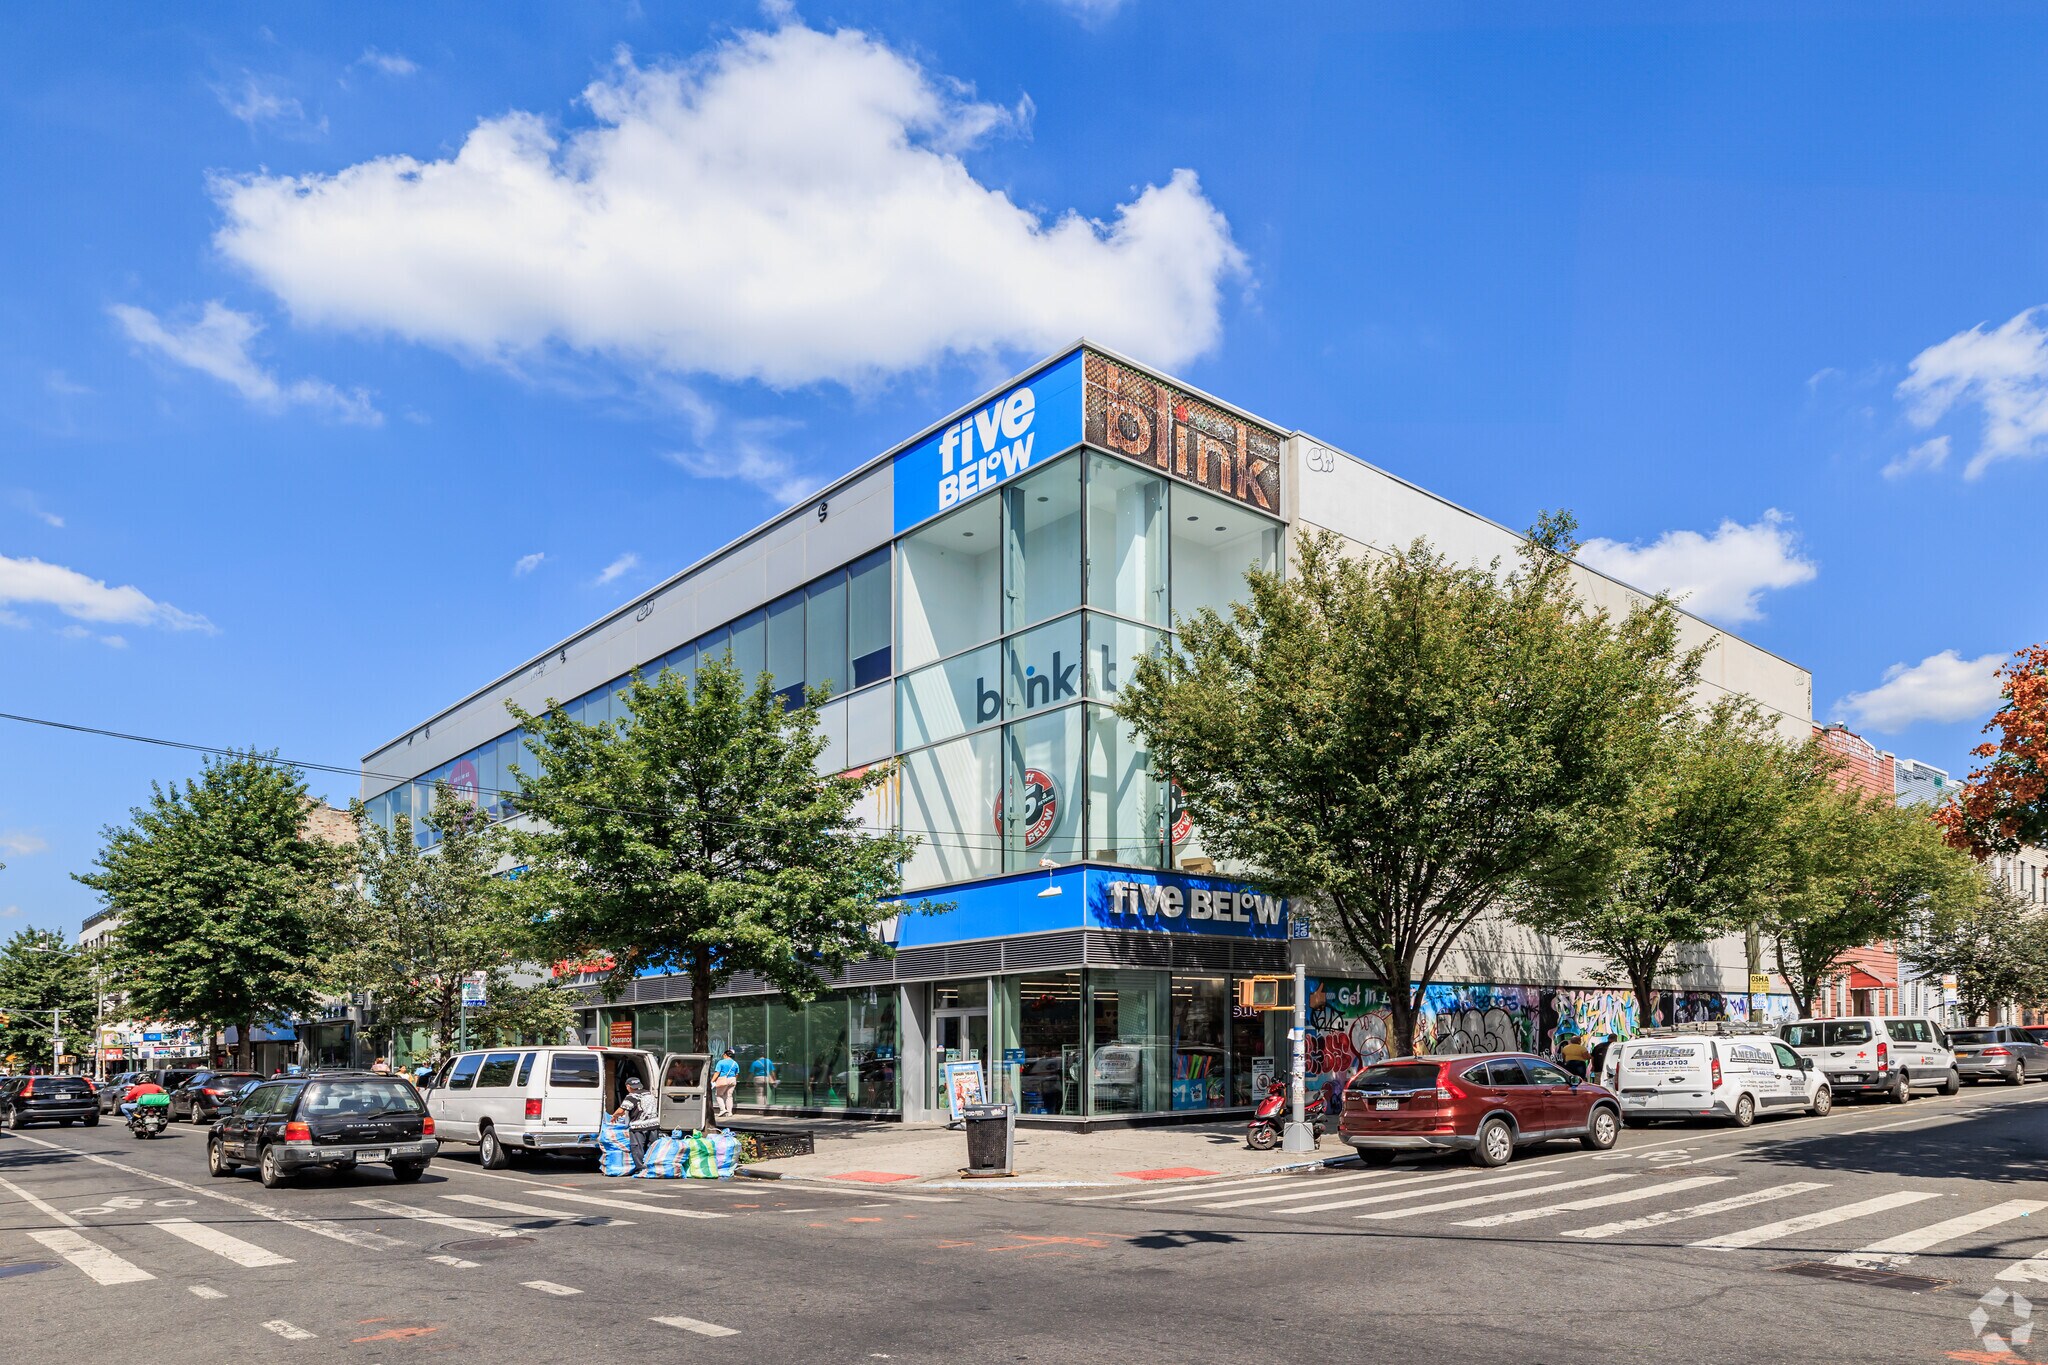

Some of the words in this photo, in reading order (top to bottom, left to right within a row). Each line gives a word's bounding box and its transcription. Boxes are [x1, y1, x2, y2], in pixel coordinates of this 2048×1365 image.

[939, 387, 1035, 476] five
[1106, 364, 1271, 509] blink
[1111, 880, 1184, 918] five
[1338, 984, 1361, 1007] Get
